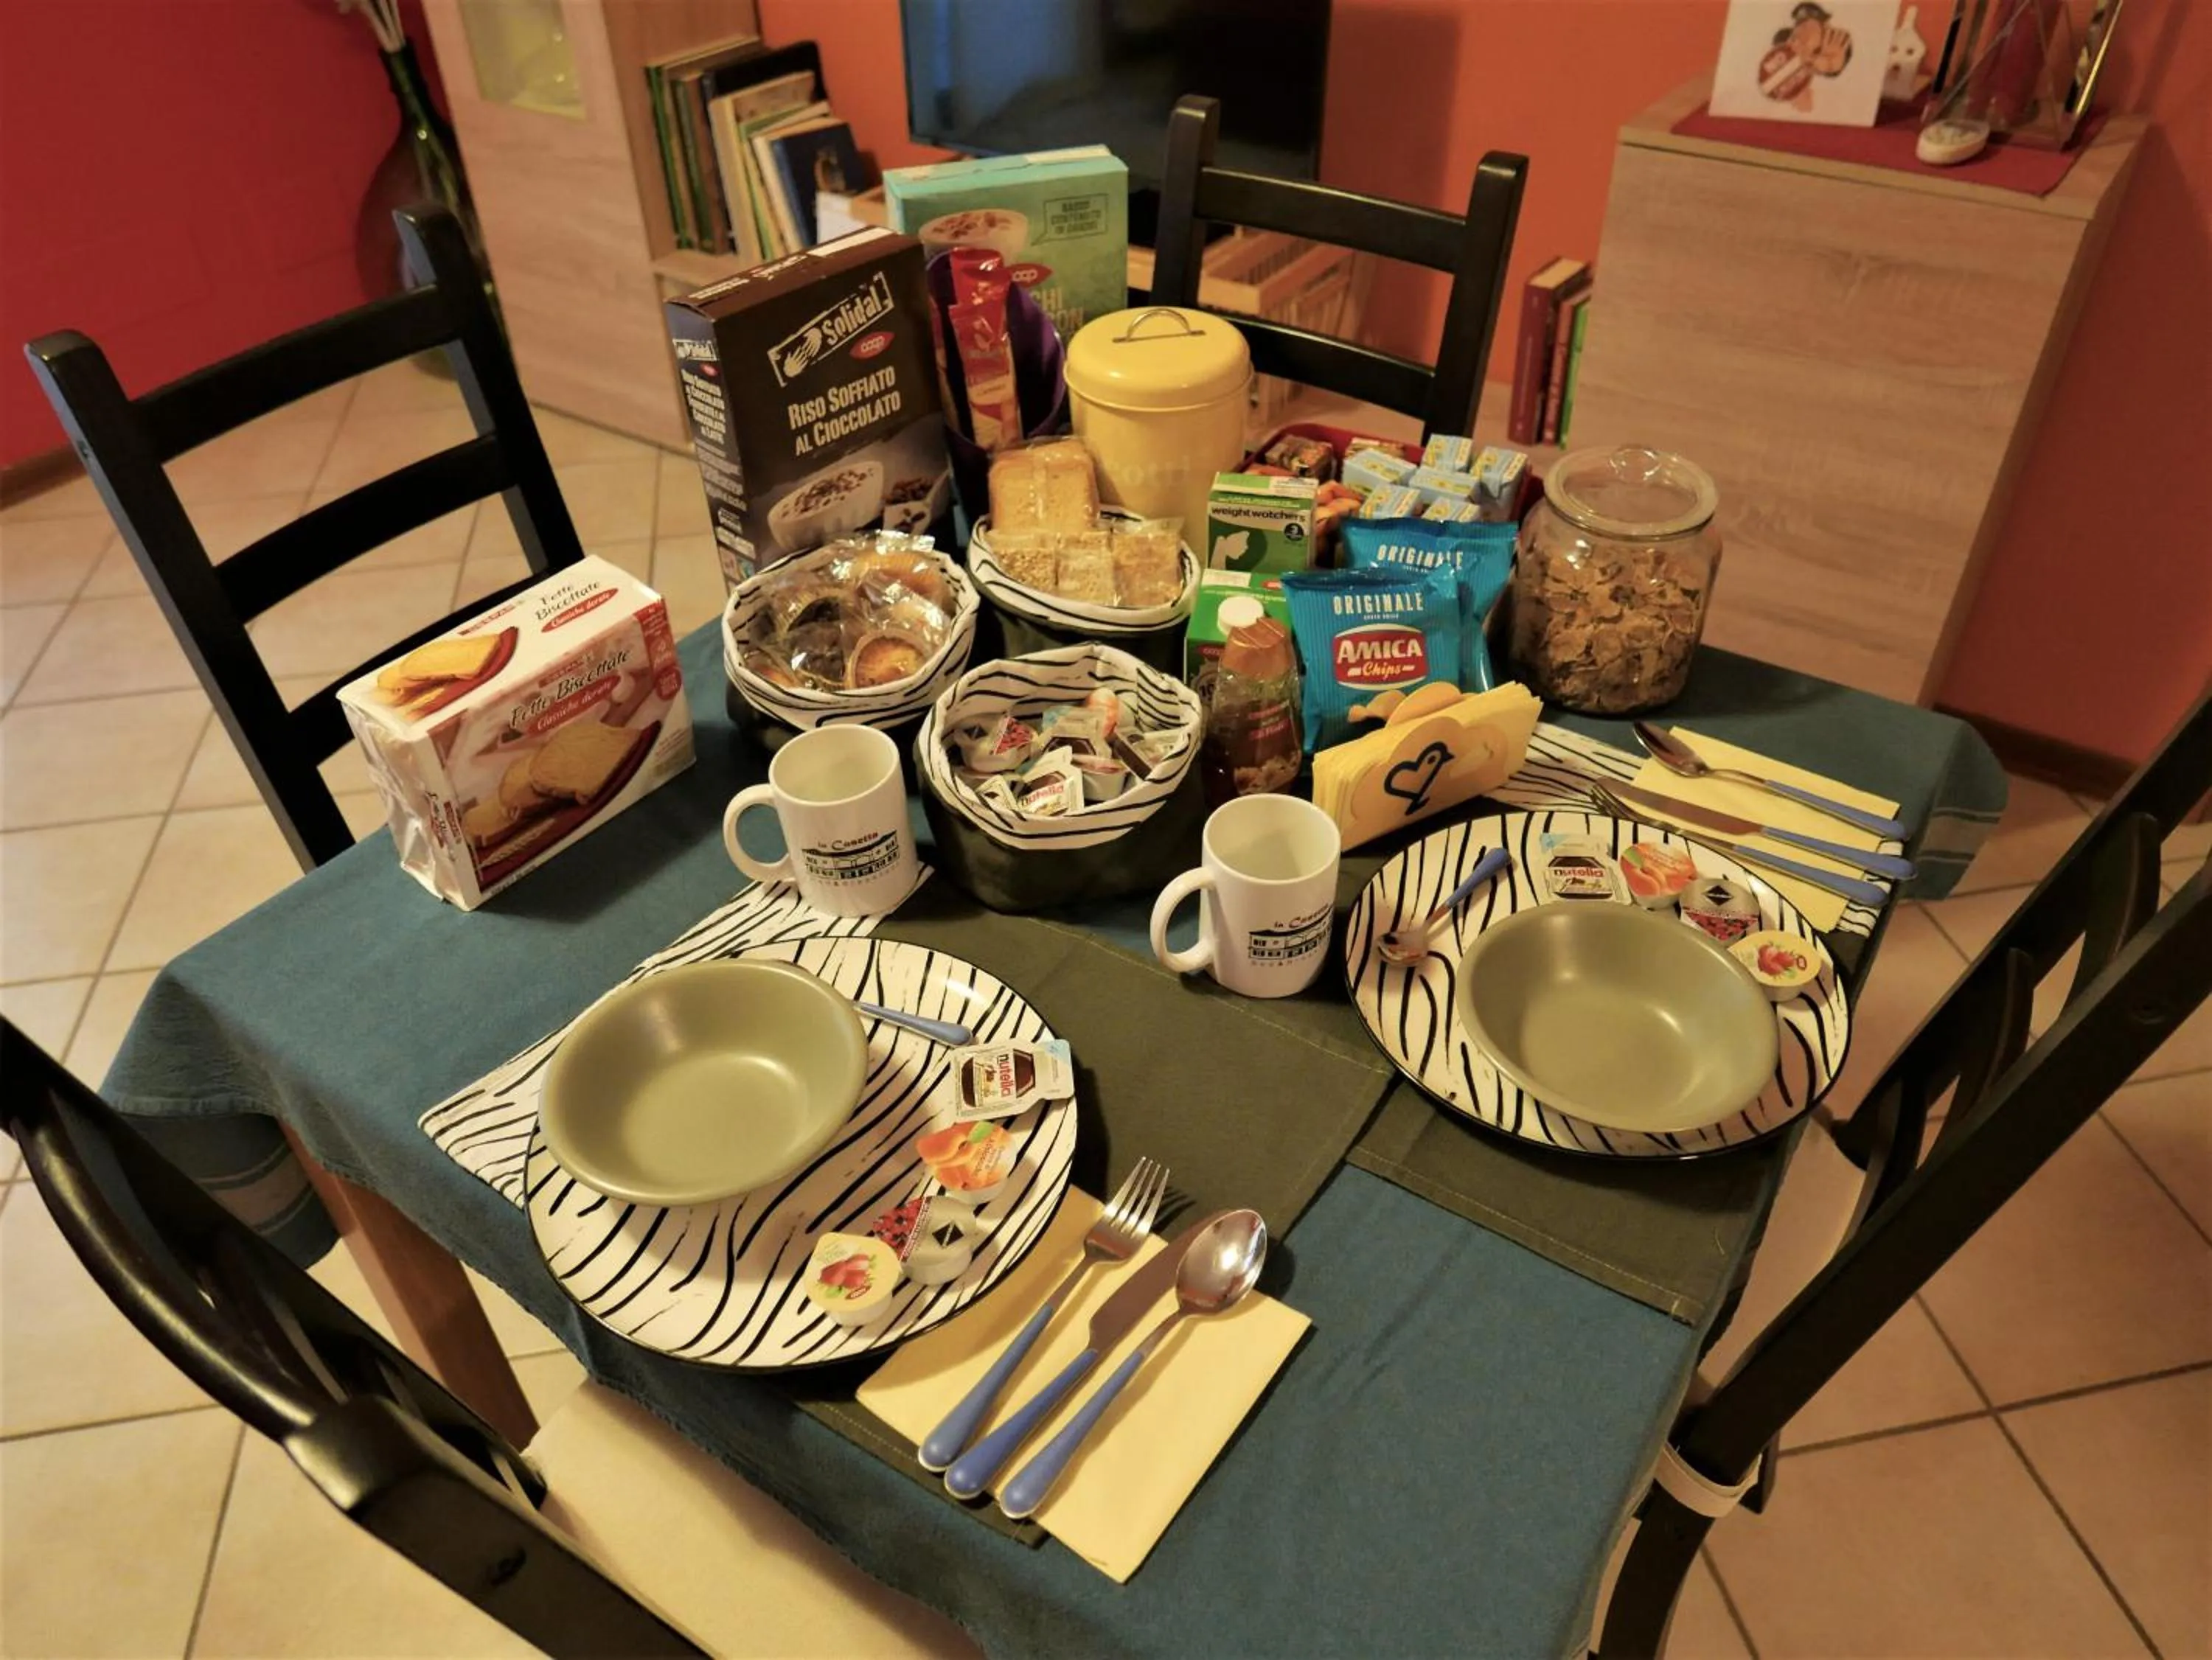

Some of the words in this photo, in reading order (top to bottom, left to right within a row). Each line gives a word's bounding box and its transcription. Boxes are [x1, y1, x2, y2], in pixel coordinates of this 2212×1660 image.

[821, 285, 883, 346] Solidal
[860, 335, 885, 353] coop
[787, 397, 827, 430] RISO
[827, 366, 897, 413] SOFFIATO
[813, 391, 902, 447] CIOCCOLATO
[1333, 593, 1424, 615] ORIGINALE
[1337, 638, 1424, 665] AMICA
[1362, 661, 1402, 681] Chips
[1553, 868, 1604, 879] nutella
[997, 1053, 1014, 1098] nutella
